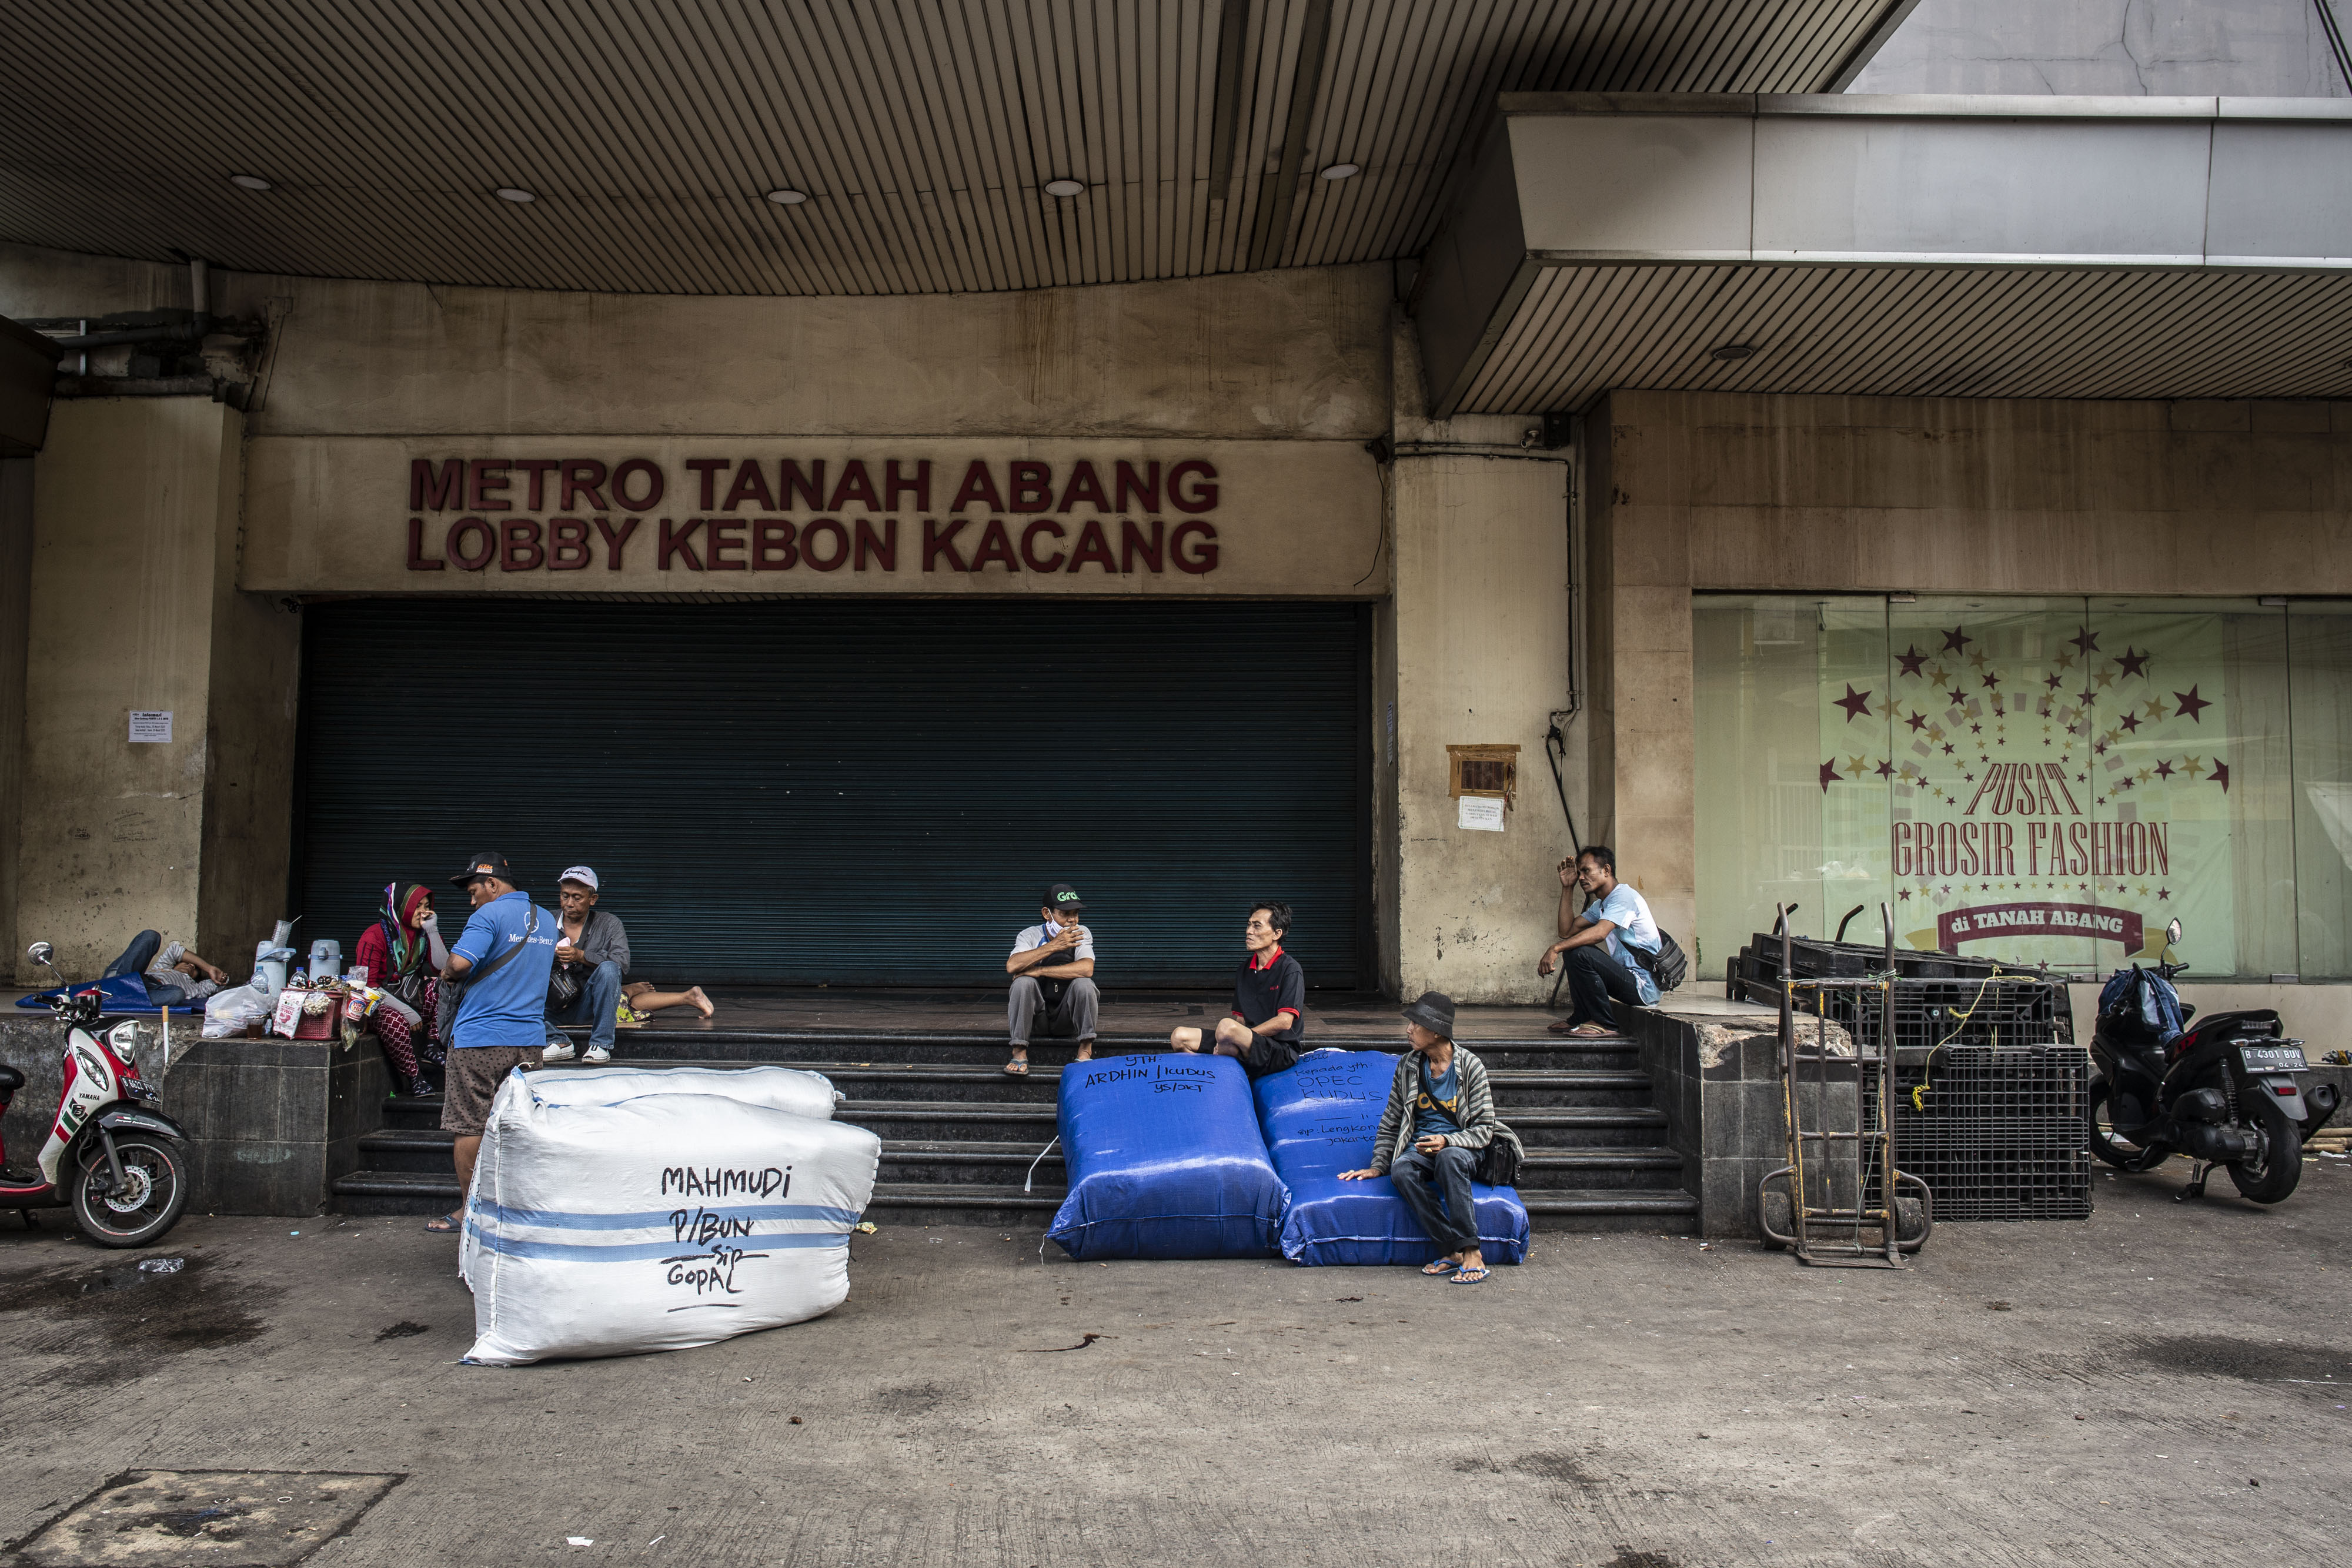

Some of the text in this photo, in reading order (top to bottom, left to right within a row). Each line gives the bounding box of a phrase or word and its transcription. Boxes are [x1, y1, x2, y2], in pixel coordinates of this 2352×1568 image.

[410, 459, 1219, 514] METRO TANAH ABANG
[407, 517, 1219, 574] LOBBY KEBON KACANG
[1963, 763, 2083, 815] PUSAT
[1892, 821, 2169, 877] GROSIR FASHION
[1057, 890, 1081, 902] Gra
[1951, 909, 2124, 934] di TANAH ABANG
[508, 934, 553, 945] Merdes-Benz
[2244, 1050, 2301, 1059] B 4301 BUV
[122, 1077, 129, 1087] B
[1085, 1069, 1148, 1088] ARDHIN
[1165, 1067, 1216, 1079] KUDUS
[1297, 1075, 1364, 1087] OPEC
[79, 1092, 100, 1101] YAMAHA
[1302, 1089, 1384, 1102] KUDUS
